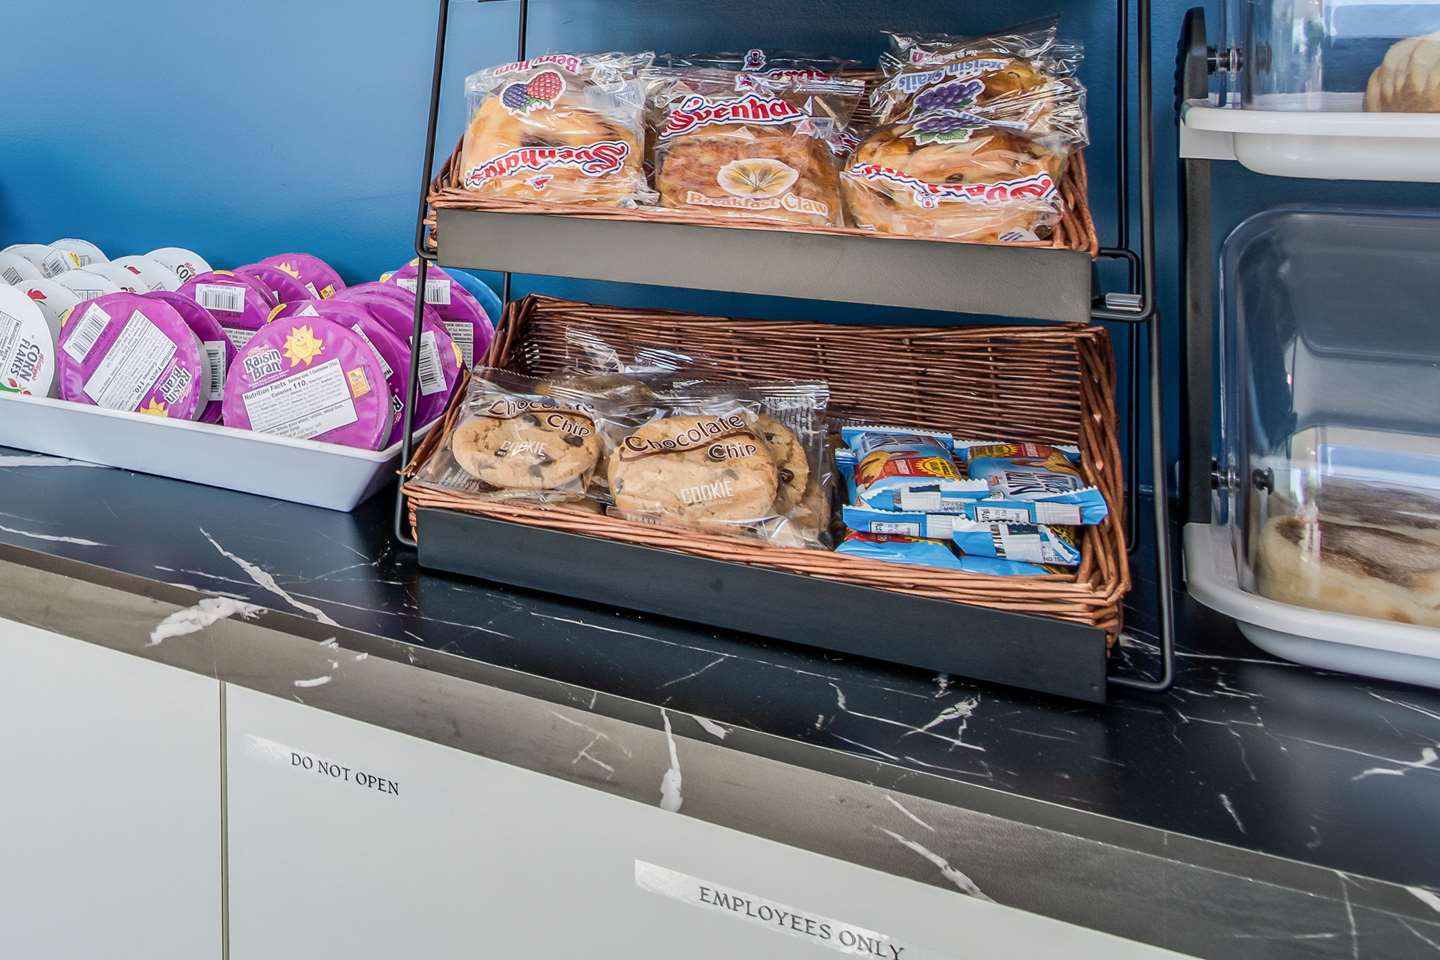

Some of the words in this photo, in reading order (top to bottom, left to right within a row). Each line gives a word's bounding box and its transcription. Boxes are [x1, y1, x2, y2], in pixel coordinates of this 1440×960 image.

[532, 54, 579, 74] Berry
[688, 193, 779, 209] Breakfast
[783, 195, 827, 215] Claw
[11, 338, 30, 377] FLAKES
[19, 344, 40, 382] CORN
[245, 350, 281, 372] Raisin
[162, 365, 182, 394] Bran
[251, 362, 281, 380] Bran
[166, 368, 190, 403] Raisin
[270, 381, 287, 391] Facts
[547, 414, 591, 437] Chip
[624, 414, 745, 451] Chocolate
[709, 442, 757, 461] Chip
[680, 480, 735, 504] COOKIE
[291, 753, 313, 770] DO
[318, 760, 351, 781] NOT
[355, 771, 399, 796] OPEN
[699, 886, 831, 940] EMPLOYEES
[839, 930, 904, 960] ONLY
